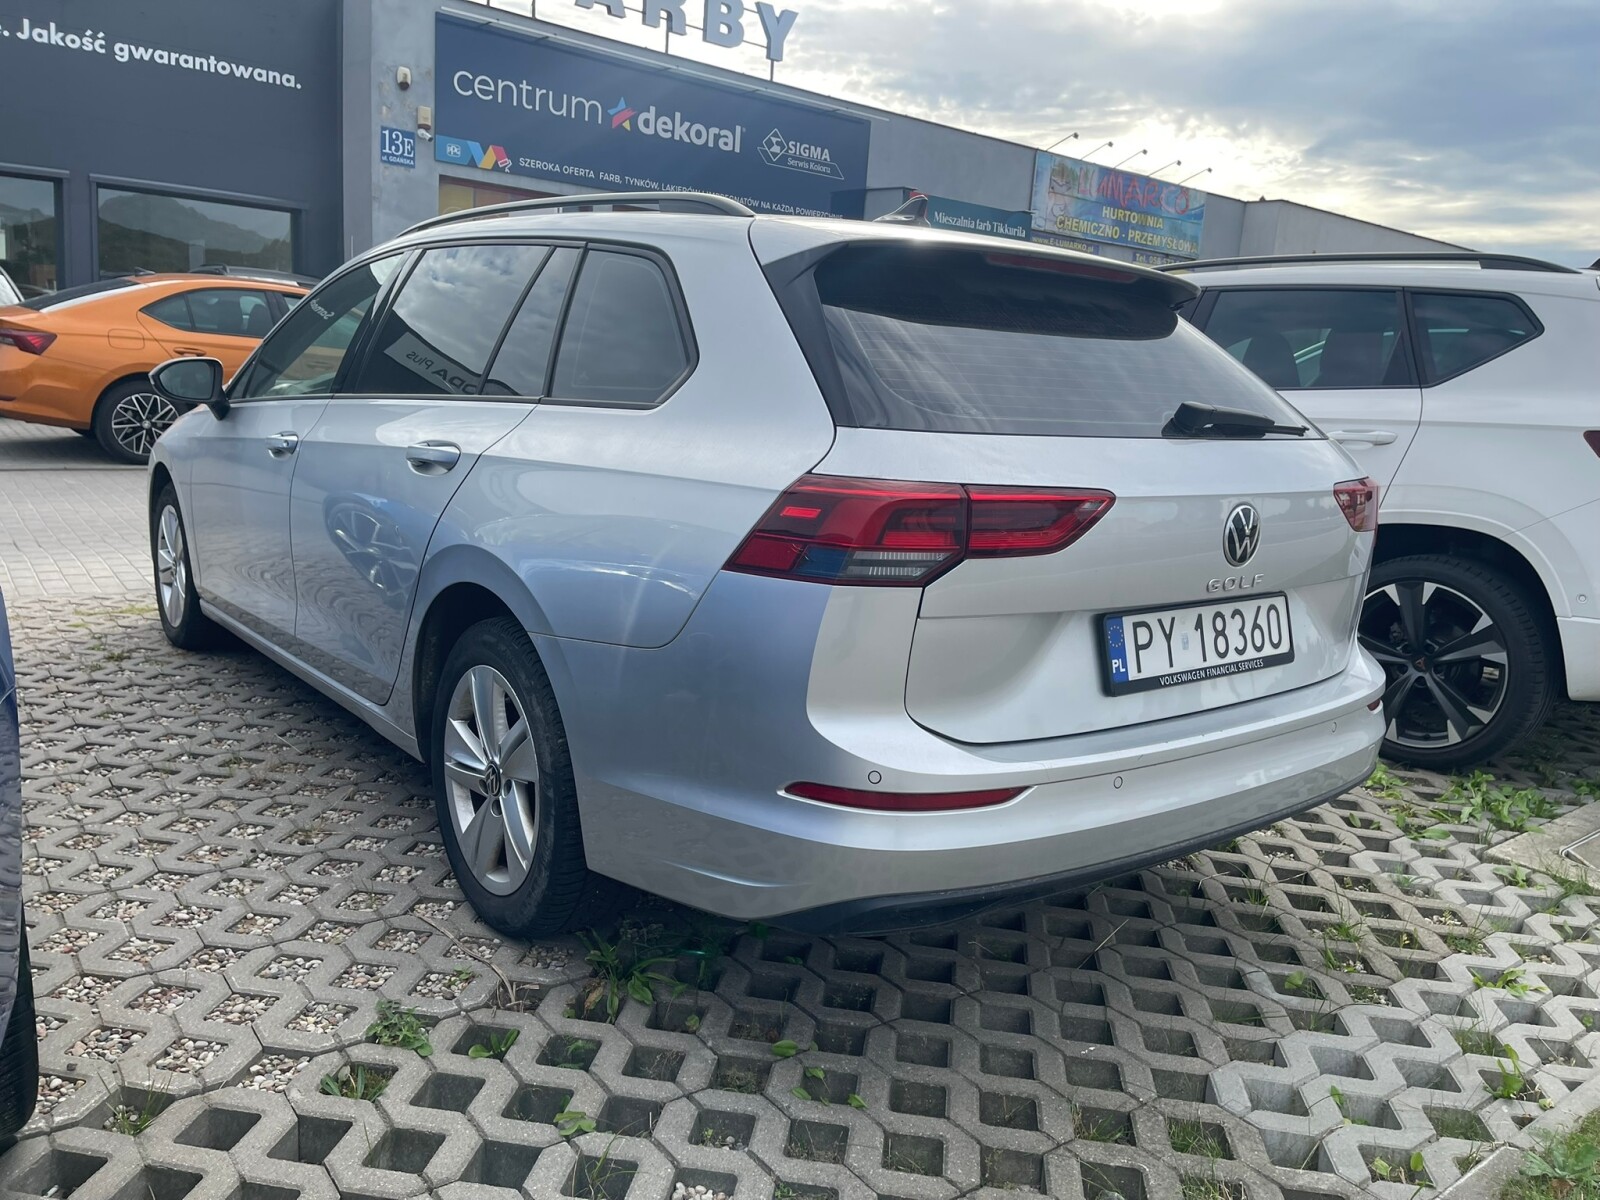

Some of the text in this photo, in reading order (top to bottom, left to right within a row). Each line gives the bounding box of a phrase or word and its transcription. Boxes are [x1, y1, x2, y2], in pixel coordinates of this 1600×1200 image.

[16, 18, 302, 89] Jakość gwarantowana.
[453, 70, 742, 153] centrum dekoral
[382, 129, 414, 157] 13E
[788, 140, 831, 162] SIGMA
[787, 157, 831, 174] Serwis Koloru
[519, 157, 561, 173] SZEROKA
[562, 165, 595, 178] OFERTA
[599, 171, 622, 184] FARB,
[624, 175, 660, 190] TYNKÓW,
[761, 202, 771, 210] NA
[772, 202, 794, 214] KAŻDĄ
[934, 211, 1026, 238] Mieszalnia farb Tikkurila
[1102, 206, 1164, 229] HURTOWNIA
[1056, 215, 1120, 239] CHEMICZNO
[1127, 229, 1198, 253] PRZEMYSŁOWA
[1206, 573, 1264, 593] GOLF
[1112, 603, 1282, 674] PL PY 18360
[1159, 658, 1264, 686] VOLKSWAGEN FINANCIAL SERVICES
